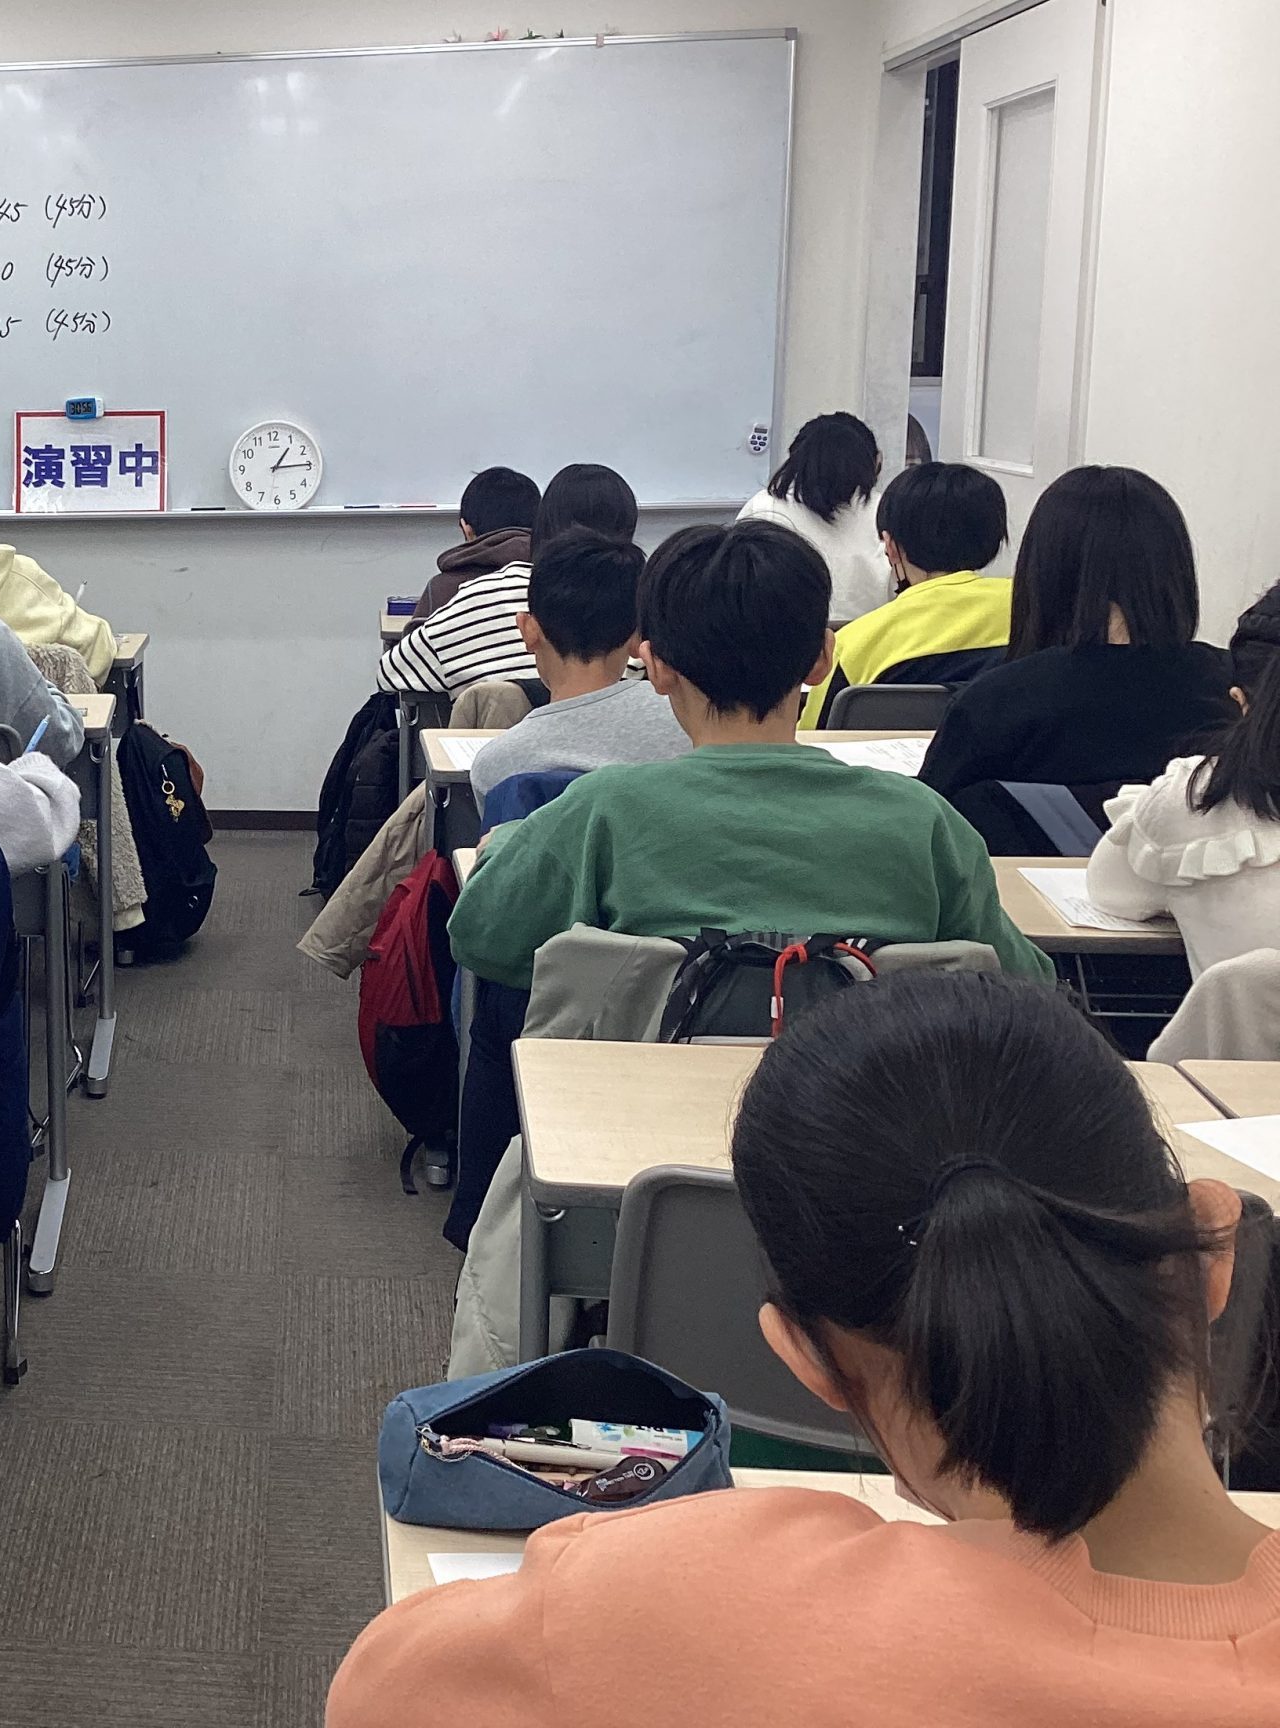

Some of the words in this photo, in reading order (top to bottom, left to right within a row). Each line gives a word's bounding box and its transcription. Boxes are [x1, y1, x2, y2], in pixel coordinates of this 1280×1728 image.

[252, 436, 263, 447] 11
[267, 430, 280, 442] 12
[287, 434, 293, 445] 1
[241, 448, 254, 460] 10
[299, 445, 307, 456] 2
[22, 443, 160, 488] 演習中
[238, 465, 246, 475] 9
[305, 460, 312, 471] 3
[245, 481, 253, 492] 8
[299, 478, 307, 488] 4
[257, 491, 265, 502] 7
[273, 494, 281, 505] 6
[289, 489, 297, 500] 5
